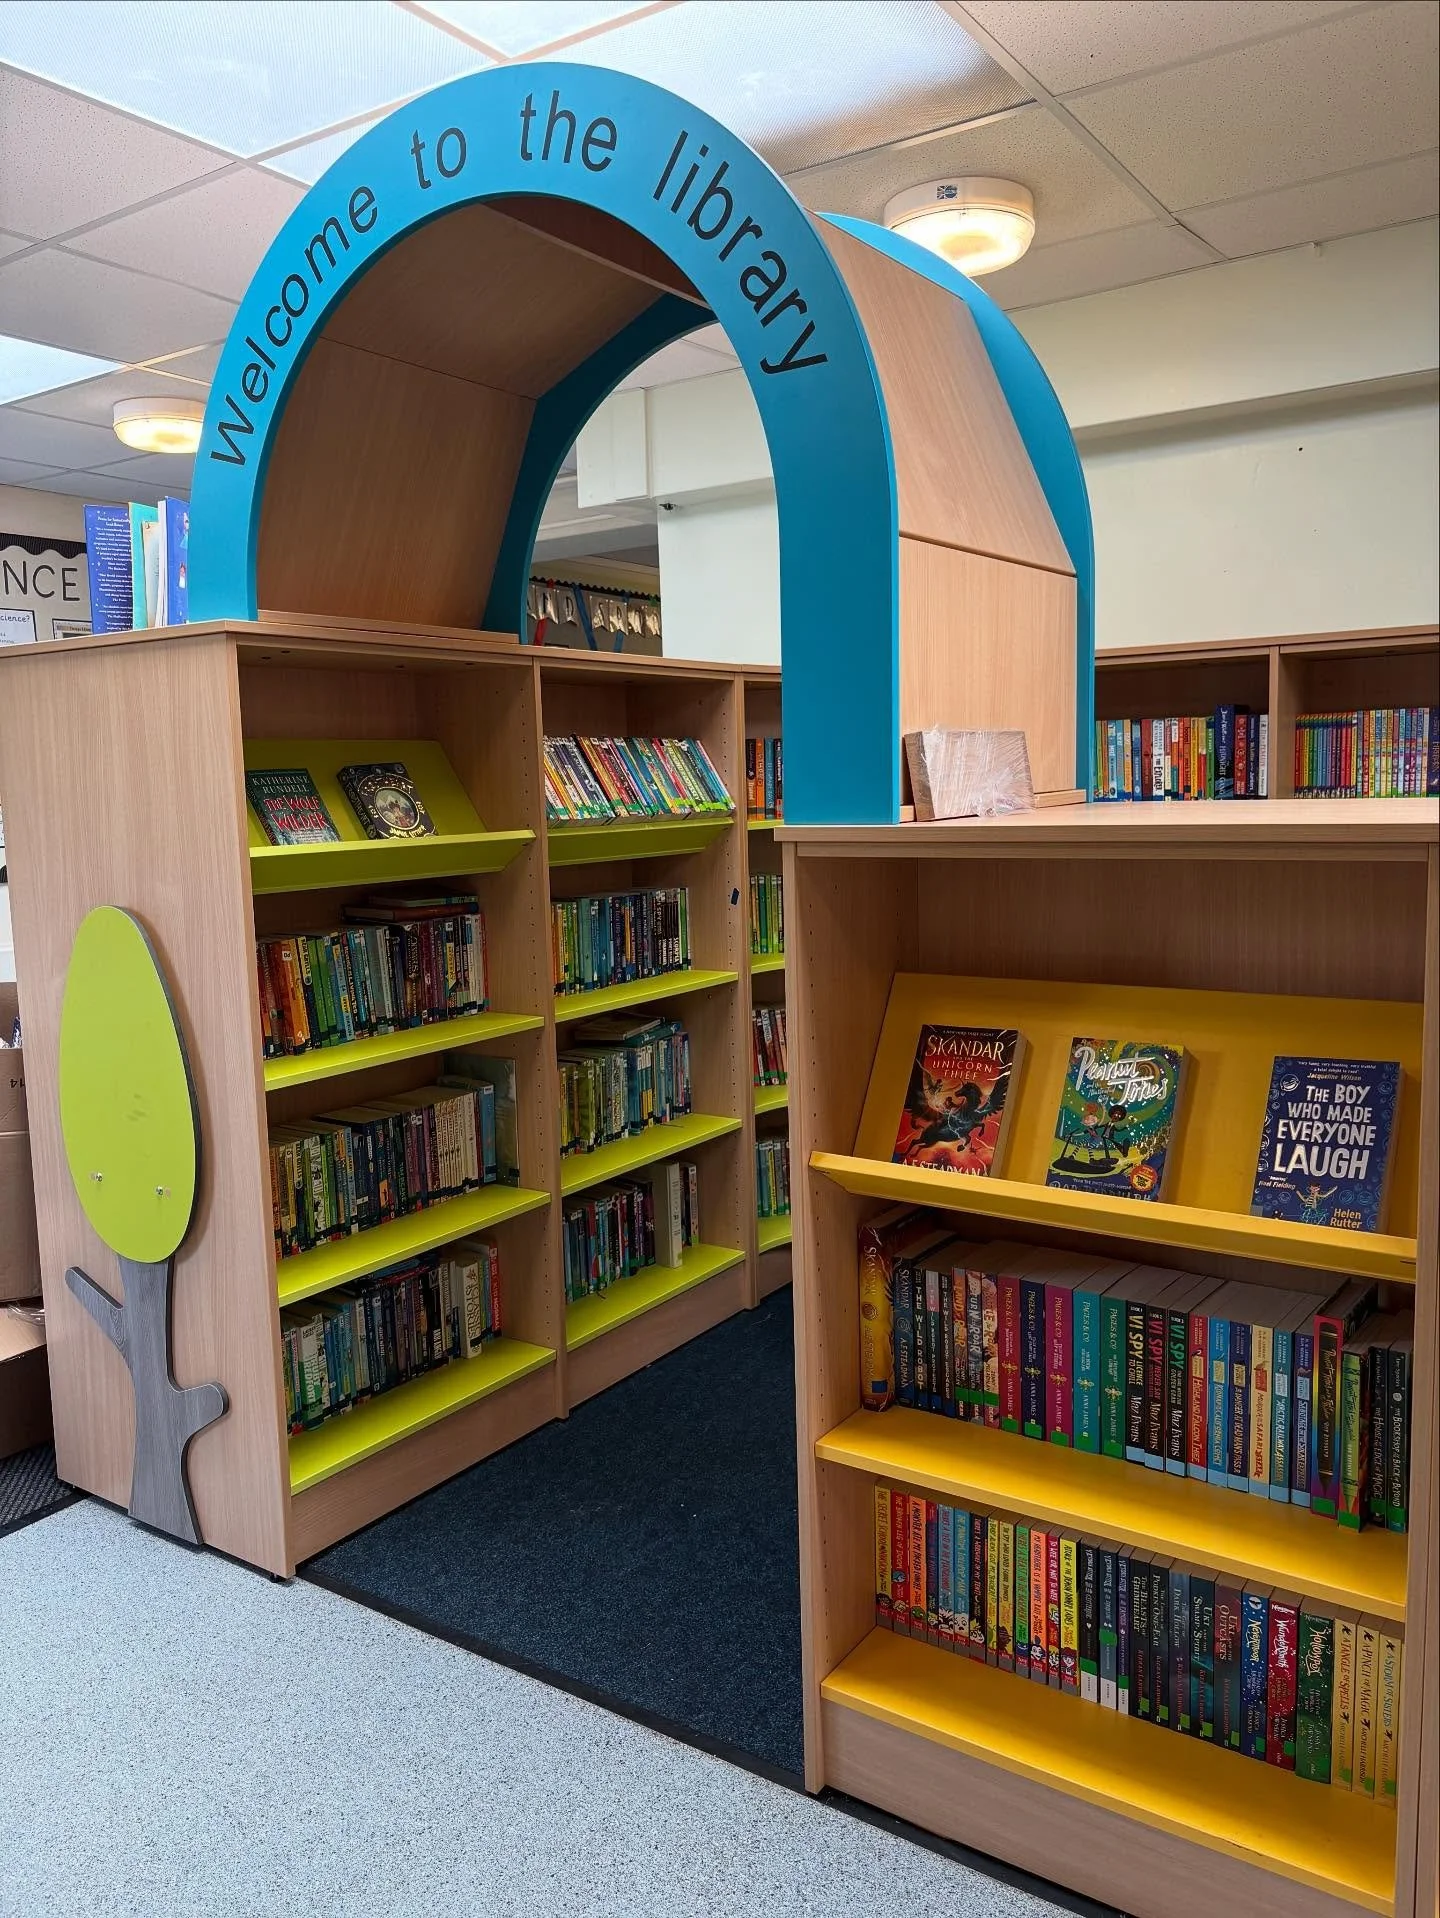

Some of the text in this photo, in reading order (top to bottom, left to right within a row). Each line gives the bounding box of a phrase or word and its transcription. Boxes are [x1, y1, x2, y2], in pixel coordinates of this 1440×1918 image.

[210, 90, 829, 467] Welcome to the library
[252, 775, 310, 785] KATHERINE
[263, 784, 309, 794] RUNDELL
[263, 795, 321, 811] THE WOLF
[271, 812, 328, 832] WILDER
[925, 1035, 1005, 1065] SKANDAR
[932, 1060, 992, 1073] UNICORN
[944, 1070, 979, 1081] THIEF
[1075, 1046, 1155, 1092] Peanut
[1307, 1072, 1339, 1081] Jacqueline
[1107, 1076, 1168, 1106] Jones
[1306, 1084, 1371, 1105] THE BOY
[1287, 1102, 1372, 1123] WHO MADE
[1277, 1119, 1377, 1146] EVERYONE
[1273, 1143, 1370, 1180] LAUGH
[1330, 1217, 1362, 1229] Rutter
[1333, 1208, 1361, 1219] Helen
[899, 1269, 910, 1309] SKANDAR
[1006, 1287, 1014, 1309] PAGES
[1028, 1291, 1036, 1313] PAGES
[955, 1285, 965, 1346] LAND ROAR
[1055, 1297, 1063, 1319] PAGES
[1083, 1301, 1091, 1324] PAGES
[1110, 1308, 1118, 1330] PAGES
[969, 1327, 983, 1353] ROAR
[1129, 1315, 1143, 1359] VI SPY
[1146, 1320, 1162, 1335] VI
[1146, 1338, 1162, 1365] SPY
[1170, 1325, 1185, 1369] VI SPY
[1193, 1379, 1202, 1413] HIGHLAND
[1131, 1395, 1143, 1443] Maz Evans
[1150, 1402, 1161, 1450] Maz Evans
[1193, 1413, 1202, 1442] FALCON
[1171, 1410, 1182, 1457] Maz Evans
[1256, 1423, 1264, 1449] SAFARI
[1276, 1424, 1285, 1451] RAILWAY
[1374, 1417, 1384, 1466] HOUSE EDGE
[1392, 1416, 1402, 1476] BOOKSHOP BACK
[878, 1503, 888, 1524] SECRET
[1050, 1560, 1057, 1568] OR
[1064, 1545, 1073, 1561] ATTACK
[1050, 1582, 1057, 1590] TO
[1064, 1576, 1073, 1592] DEMON
[1133, 1576, 1141, 1631] GRIMHEART
[1140, 1590, 1148, 1628] BEASTS
[1152, 1575, 1160, 1646] PODKIN ONE-EAR
[1203, 1606, 1212, 1626] UKI
[1173, 1589, 1182, 1649] DARK HOLLOW
[1193, 1596, 1203, 1662] SWAMP-SPIRIT
[1229, 1615, 1237, 1636] UKI
[1219, 1605, 1229, 1661] OUTCASTS
[1341, 1643, 1350, 1673] TANGLE
[1361, 1649, 1371, 1677] PINCH
[1340, 1681, 1350, 1710] SPELLS
[1361, 1686, 1371, 1716] MAGIC
[1384, 1659, 1394, 1727] STORM OF SISTERS
[1273, 1712, 1281, 1741] TOWNSEND
[1360, 1727, 1368, 1752] MICHELLE
[1359, 1753, 1367, 1784] HARRISON
